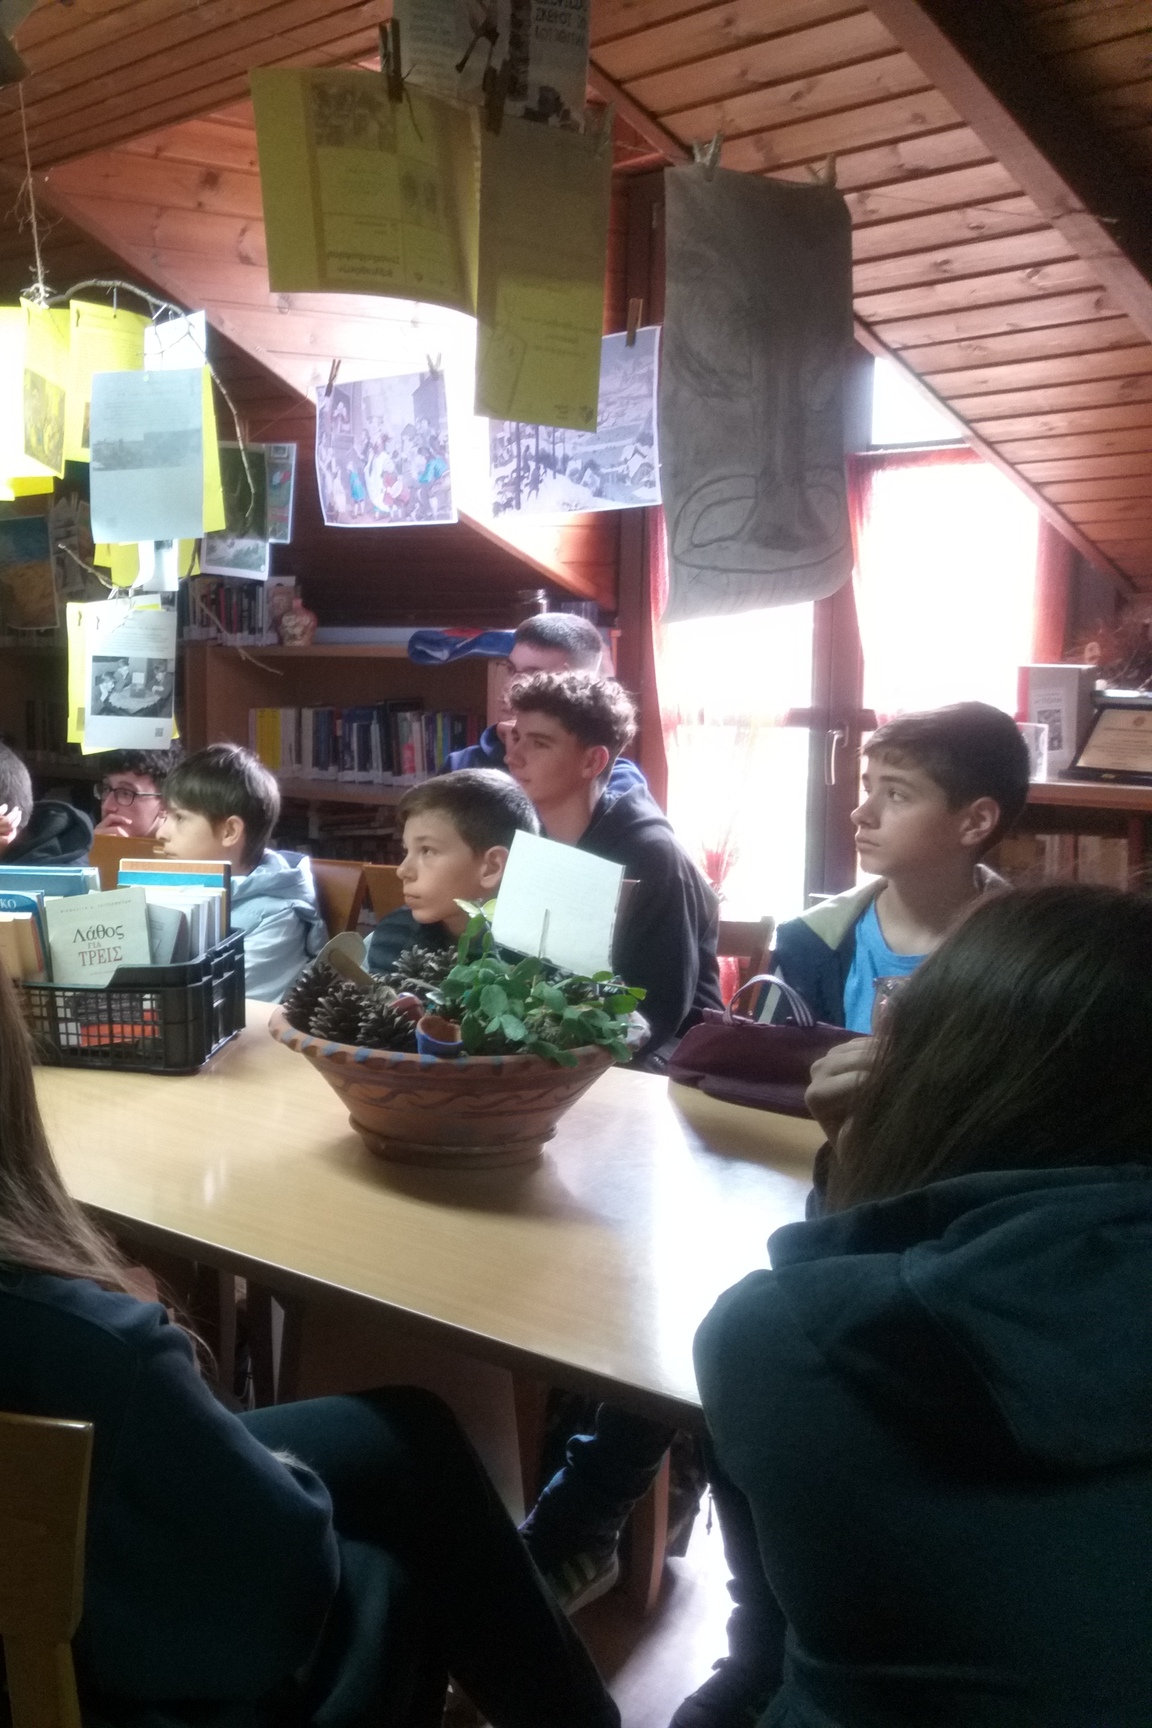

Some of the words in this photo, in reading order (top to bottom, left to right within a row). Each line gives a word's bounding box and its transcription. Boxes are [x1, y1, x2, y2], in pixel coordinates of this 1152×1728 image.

[72, 923, 125, 943] Λάθος
[87, 941, 101, 949] ΓΙΑ
[78, 945, 123, 967] ΤΡΕΙΣ
